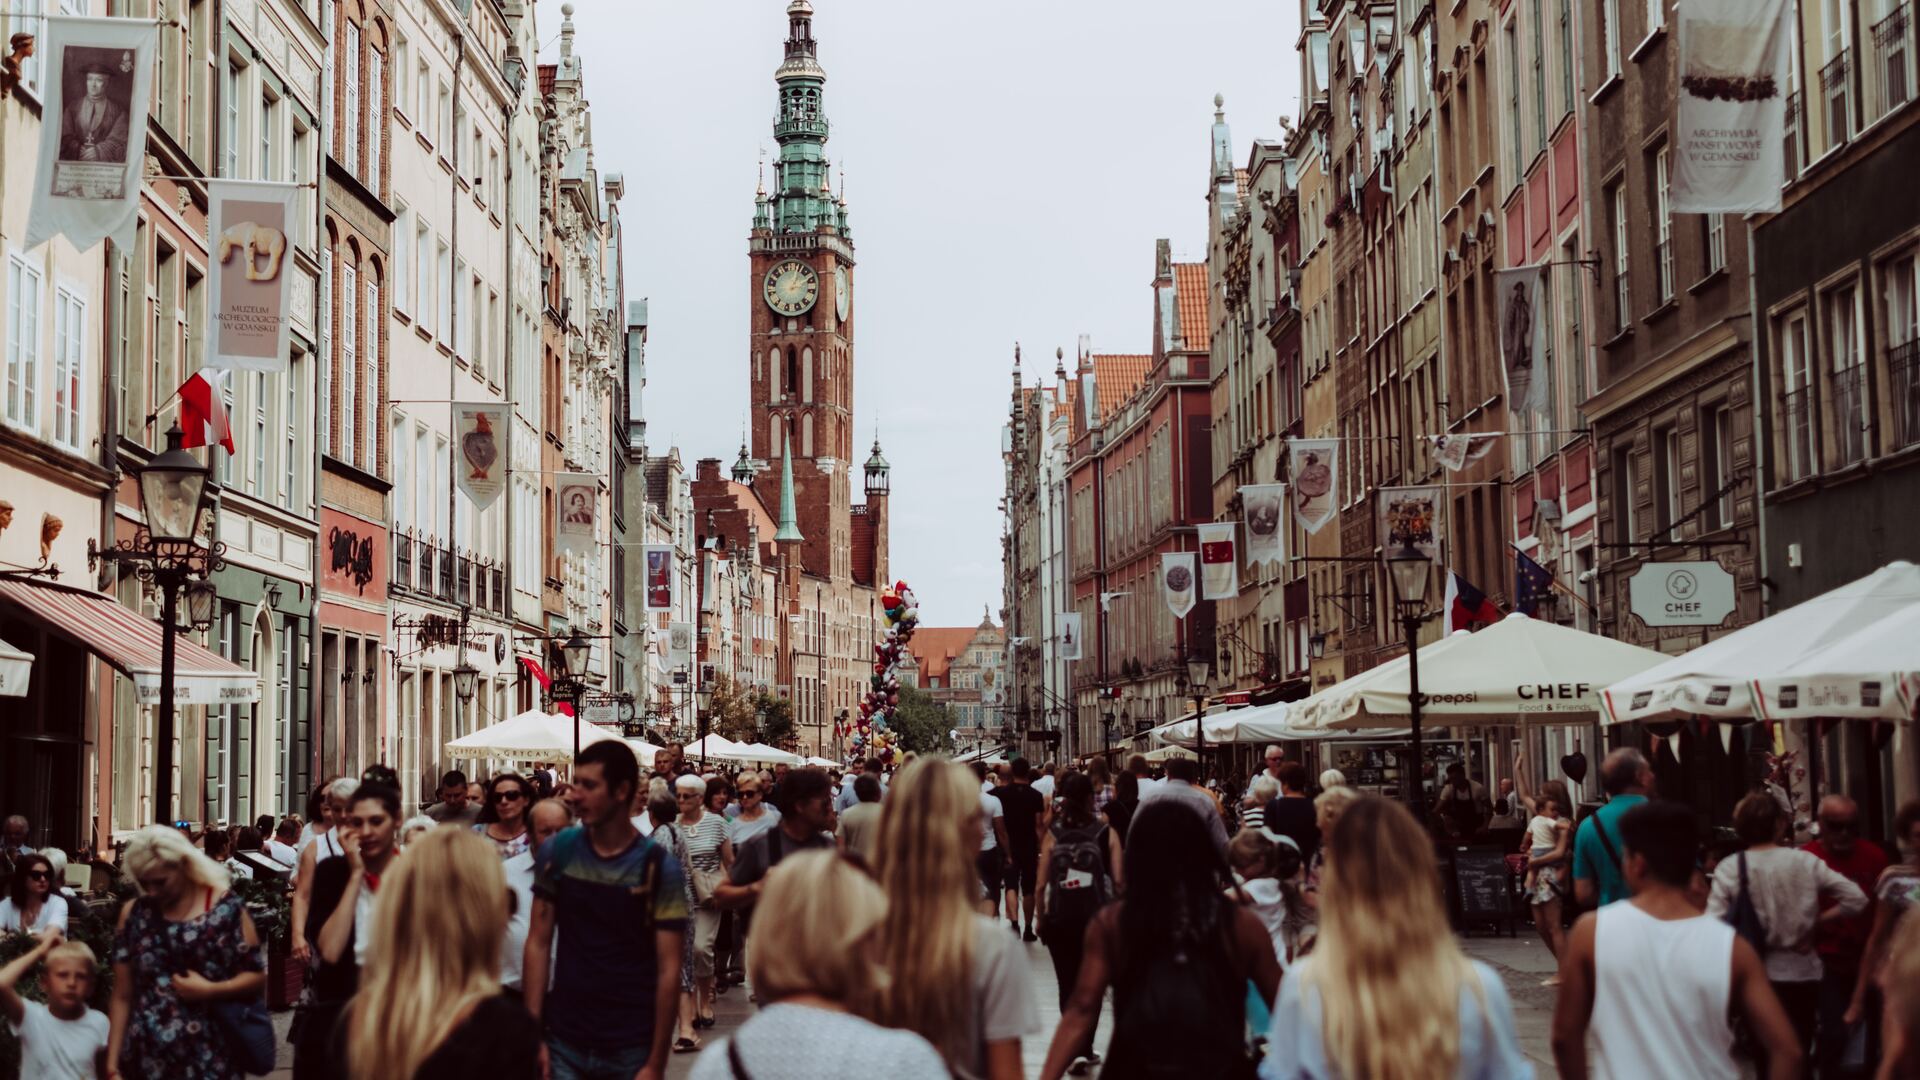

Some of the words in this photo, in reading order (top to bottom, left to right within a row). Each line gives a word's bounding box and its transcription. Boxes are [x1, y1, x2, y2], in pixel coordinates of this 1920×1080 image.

[1691, 129, 1760, 138] ARCHIWUM
[1689, 151, 1701, 161] W
[231, 305, 269, 314] MUZEUM
[223, 322, 233, 331] W
[1665, 602, 1701, 612] CHEF
[1517, 683, 1590, 700] CHEF
[1432, 691, 1478, 705] pepsi
[1518, 703, 1544, 712] Food
[1546, 704, 1553, 712] &
[1556, 703, 1592, 712] Friends
[503, 749, 550, 757] GRYCAN
